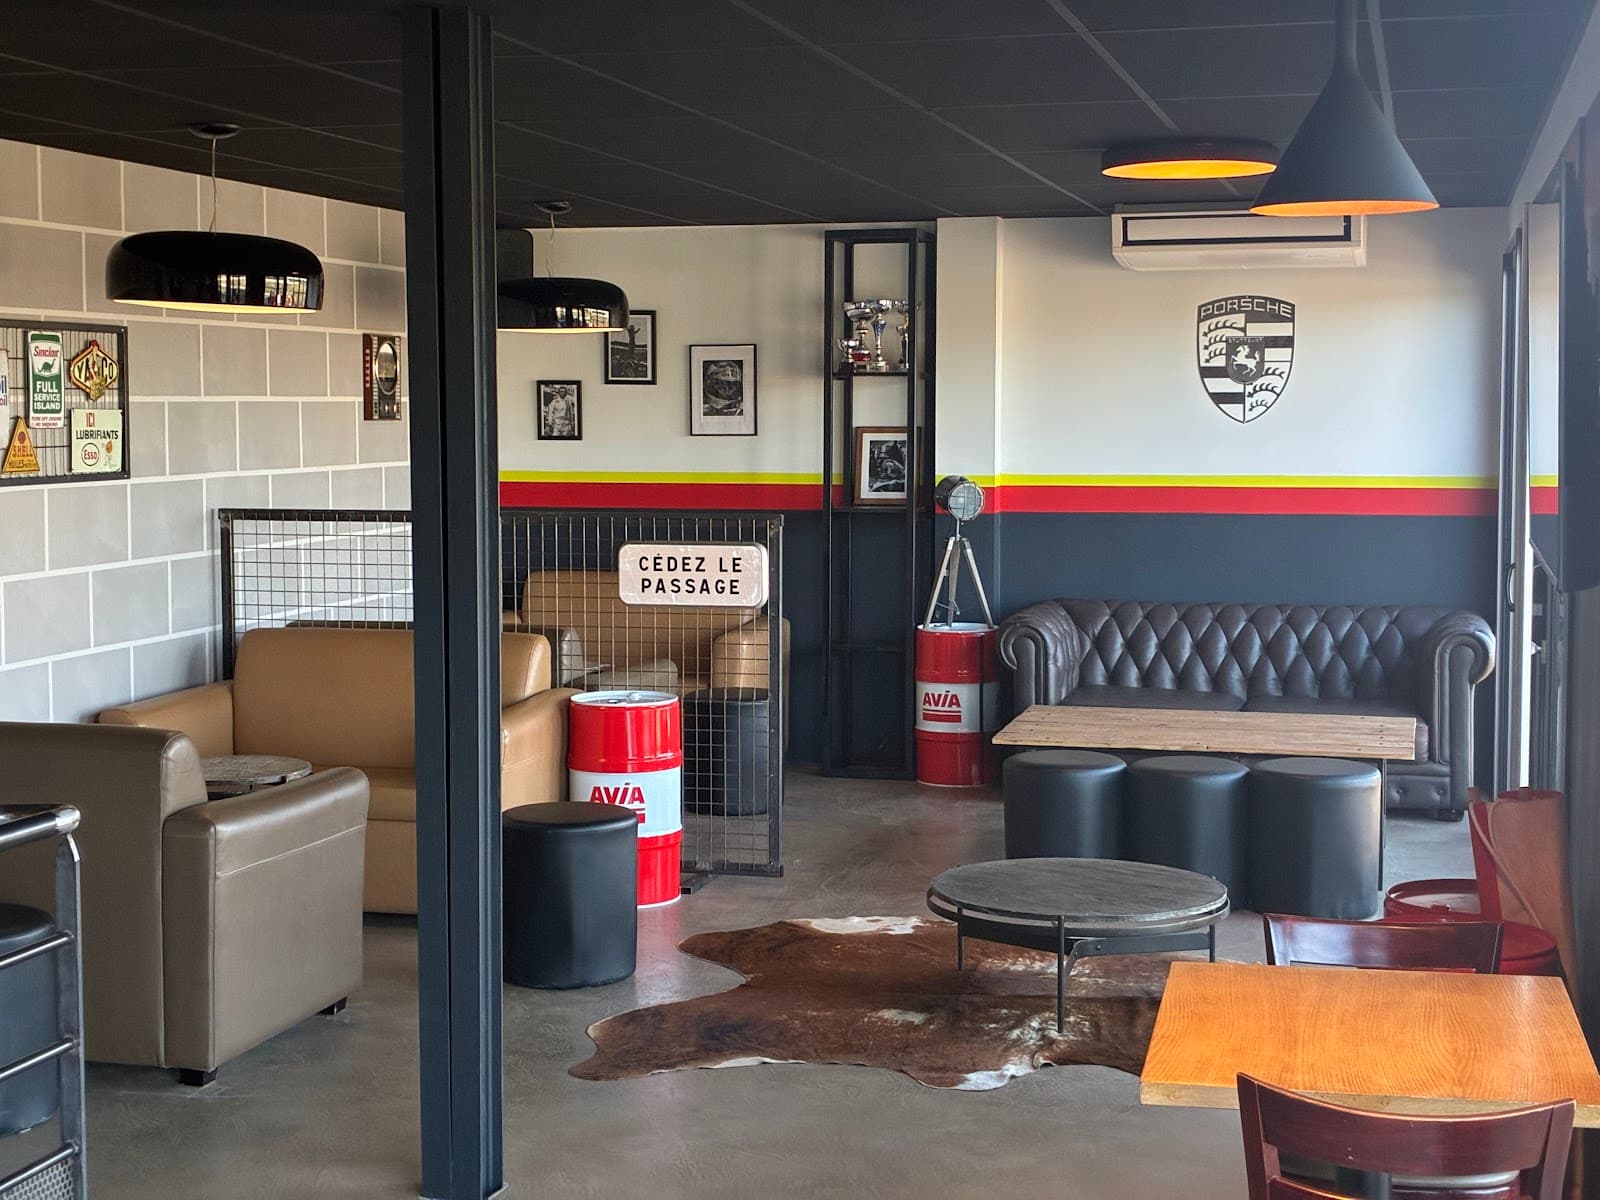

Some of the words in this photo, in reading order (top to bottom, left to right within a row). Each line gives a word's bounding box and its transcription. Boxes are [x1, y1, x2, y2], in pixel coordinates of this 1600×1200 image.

[1200, 299, 1292, 319] PORSCHE
[36, 381, 59, 393] FULL
[33, 393, 61, 402] SERVICE
[33, 401, 61, 410] ISLAND
[86, 412, 96, 428] ICI
[75, 429, 119, 440] LUBRIFIANTS
[638, 553, 706, 573] CÉDEZ
[719, 557, 743, 573] LE
[641, 578, 740, 595] PASSAGE
